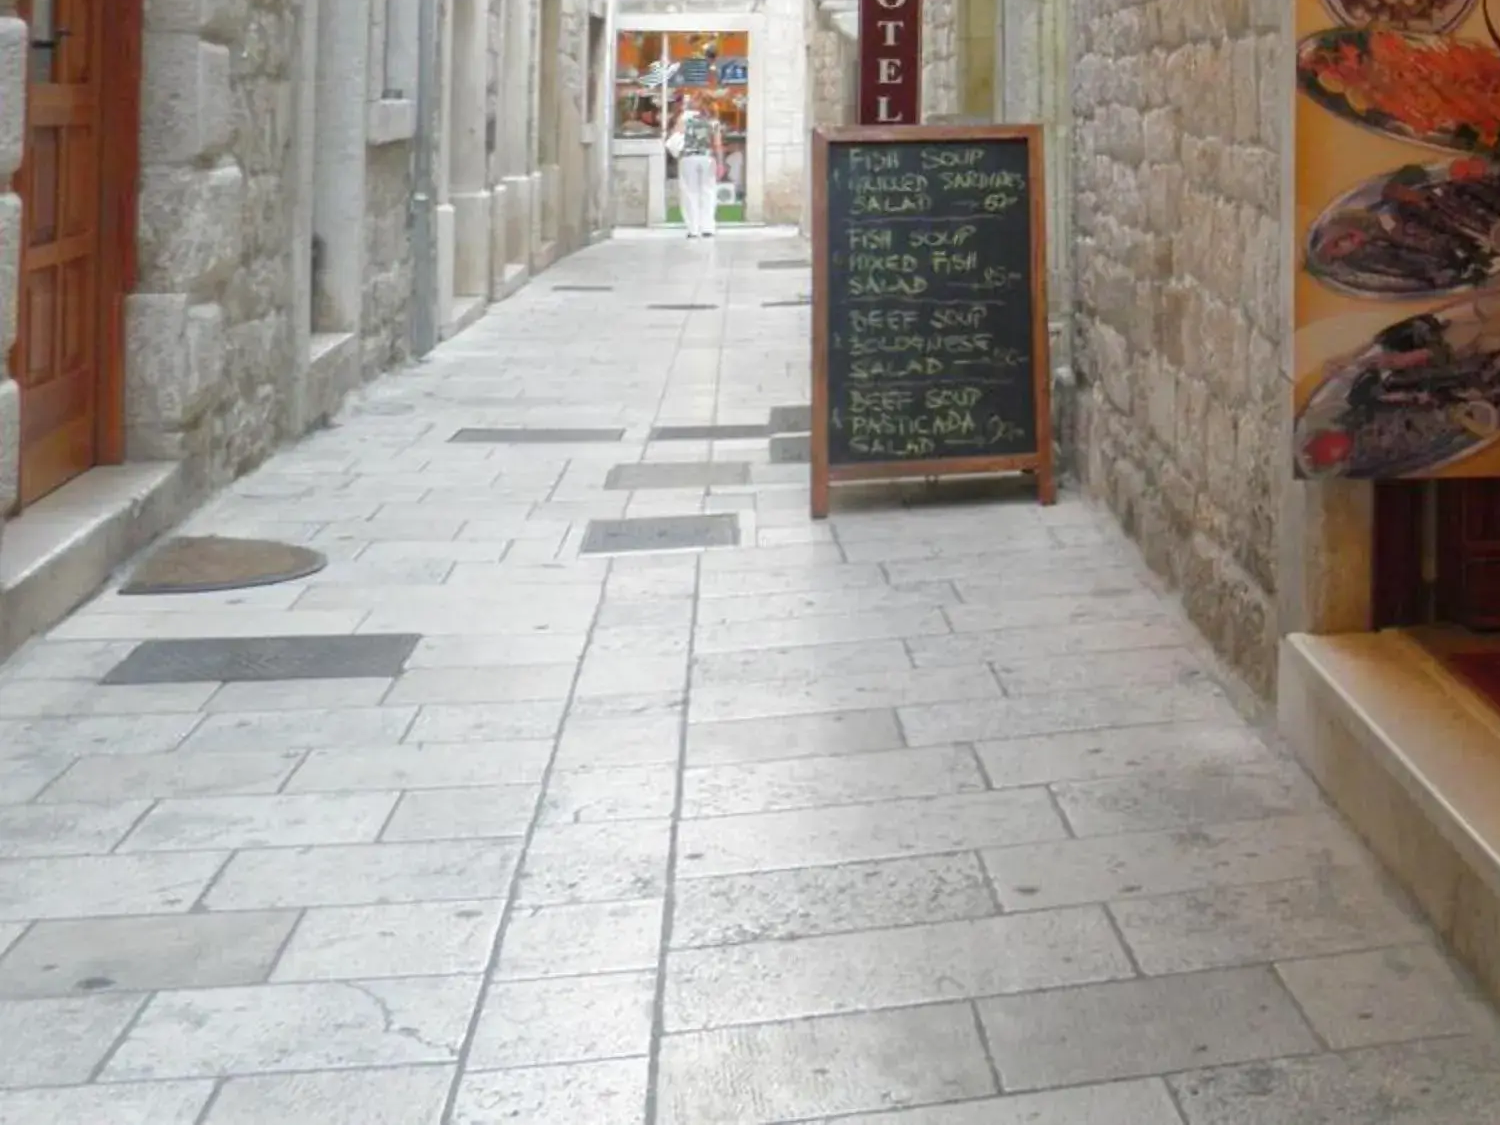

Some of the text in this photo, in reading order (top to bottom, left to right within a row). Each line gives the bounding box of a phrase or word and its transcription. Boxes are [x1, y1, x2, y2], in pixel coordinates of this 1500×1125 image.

[849, 147, 985, 171] FISH SOUP
[849, 192, 932, 215] SALAD
[846, 225, 977, 250] FISH SOUP
[848, 250, 977, 275] MIXED FISH
[847, 273, 929, 296] SALAD
[930, 306, 988, 330] SOUP
[848, 356, 944, 380] SALAD
[849, 387, 982, 413] BEEF SOUP
[848, 435, 936, 456] SALAD
